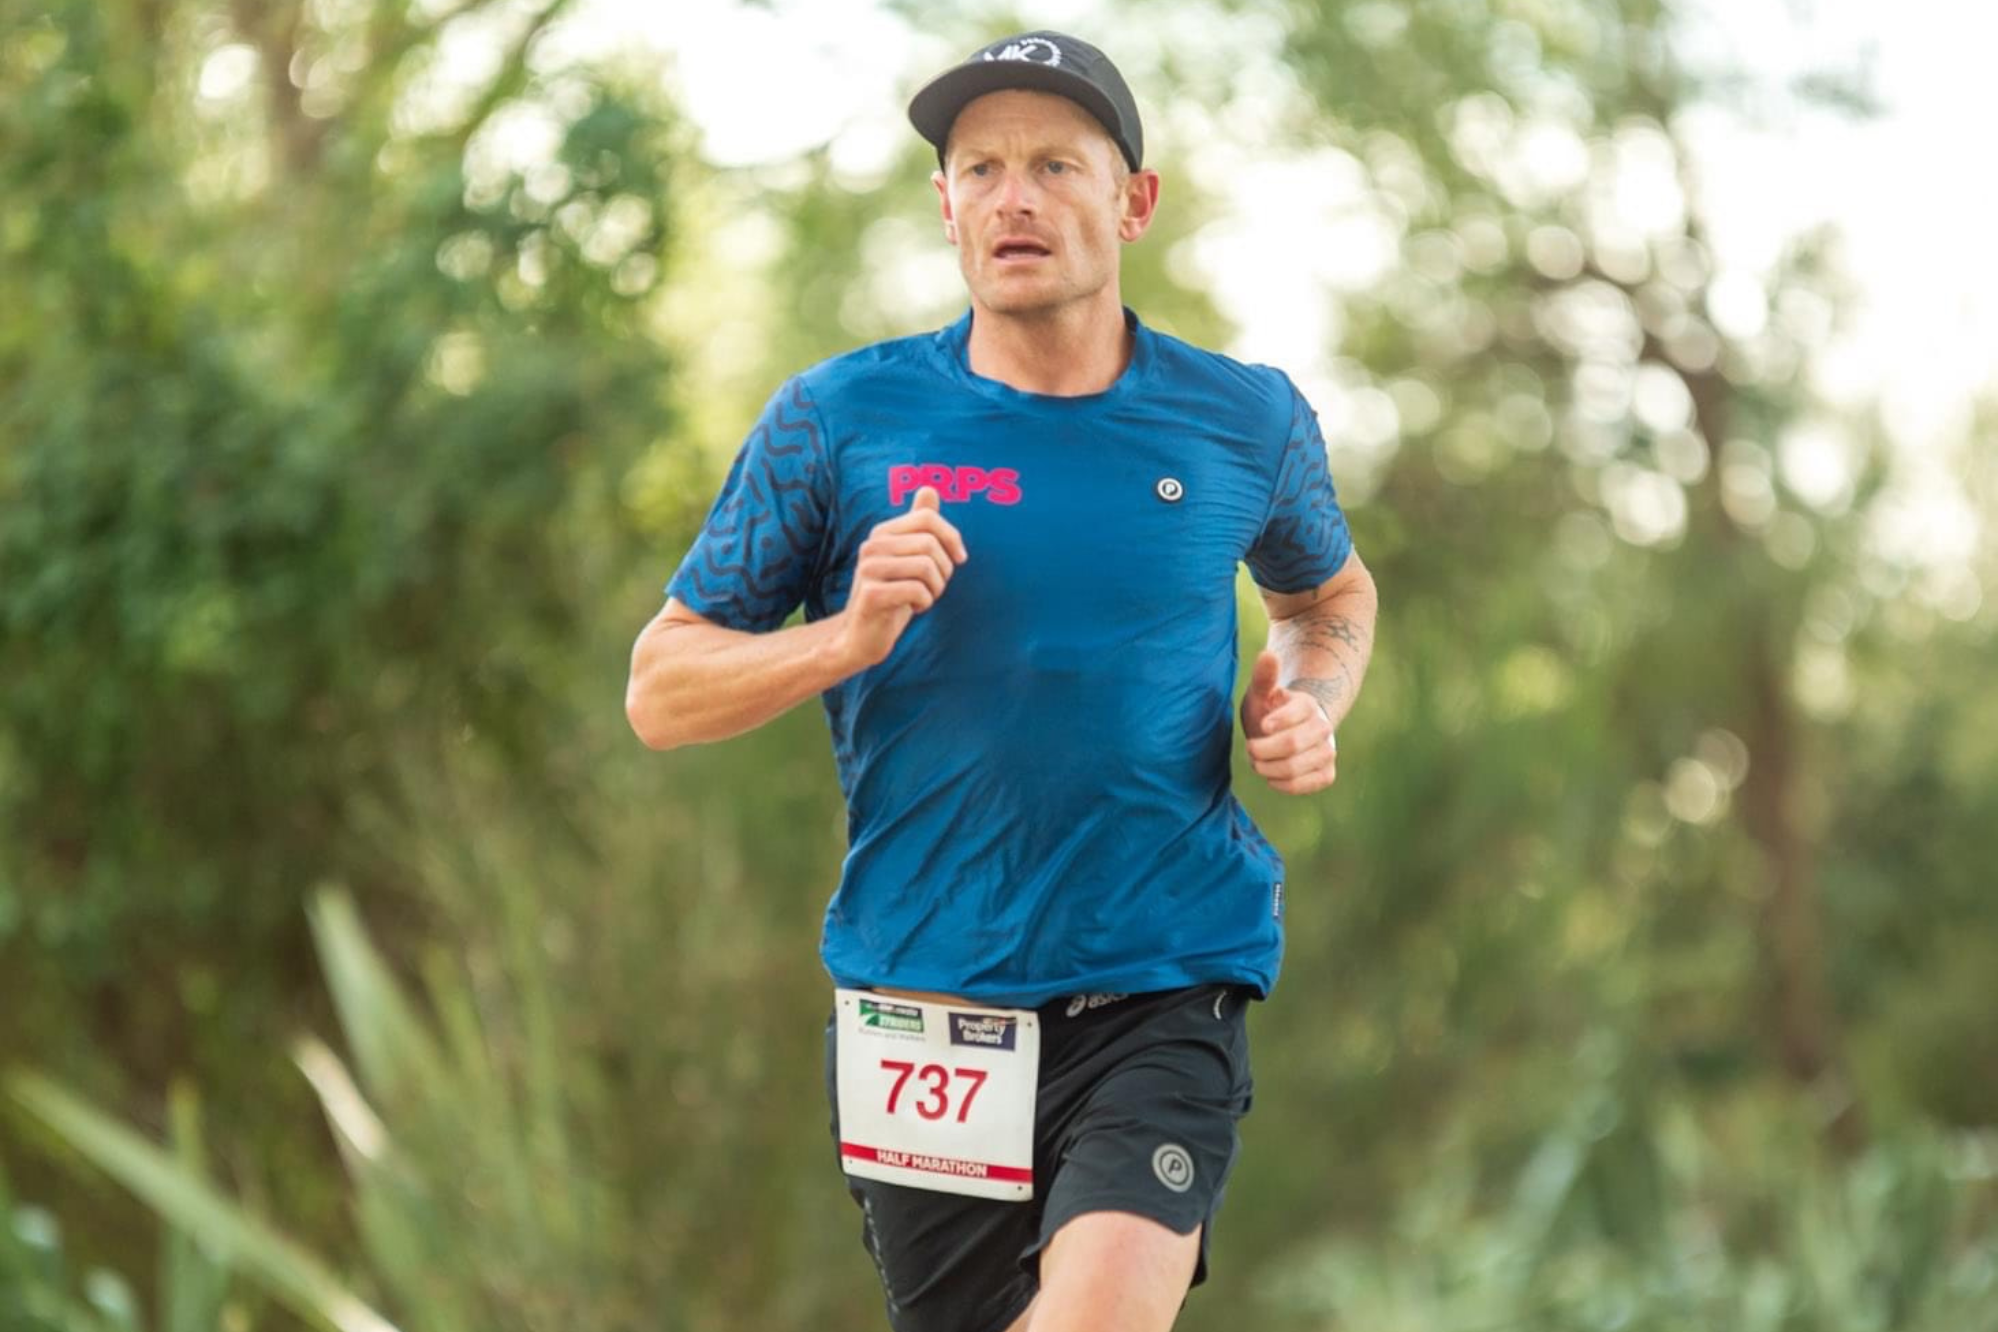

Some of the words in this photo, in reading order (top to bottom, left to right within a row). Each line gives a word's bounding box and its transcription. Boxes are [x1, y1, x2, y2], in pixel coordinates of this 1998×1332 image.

[888, 464, 1022, 506] PRPS
[957, 1018, 1006, 1036] Property
[880, 1059, 988, 1123] 737
[876, 1150, 911, 1167] HALF
[911, 1154, 988, 1178] MARATHON
